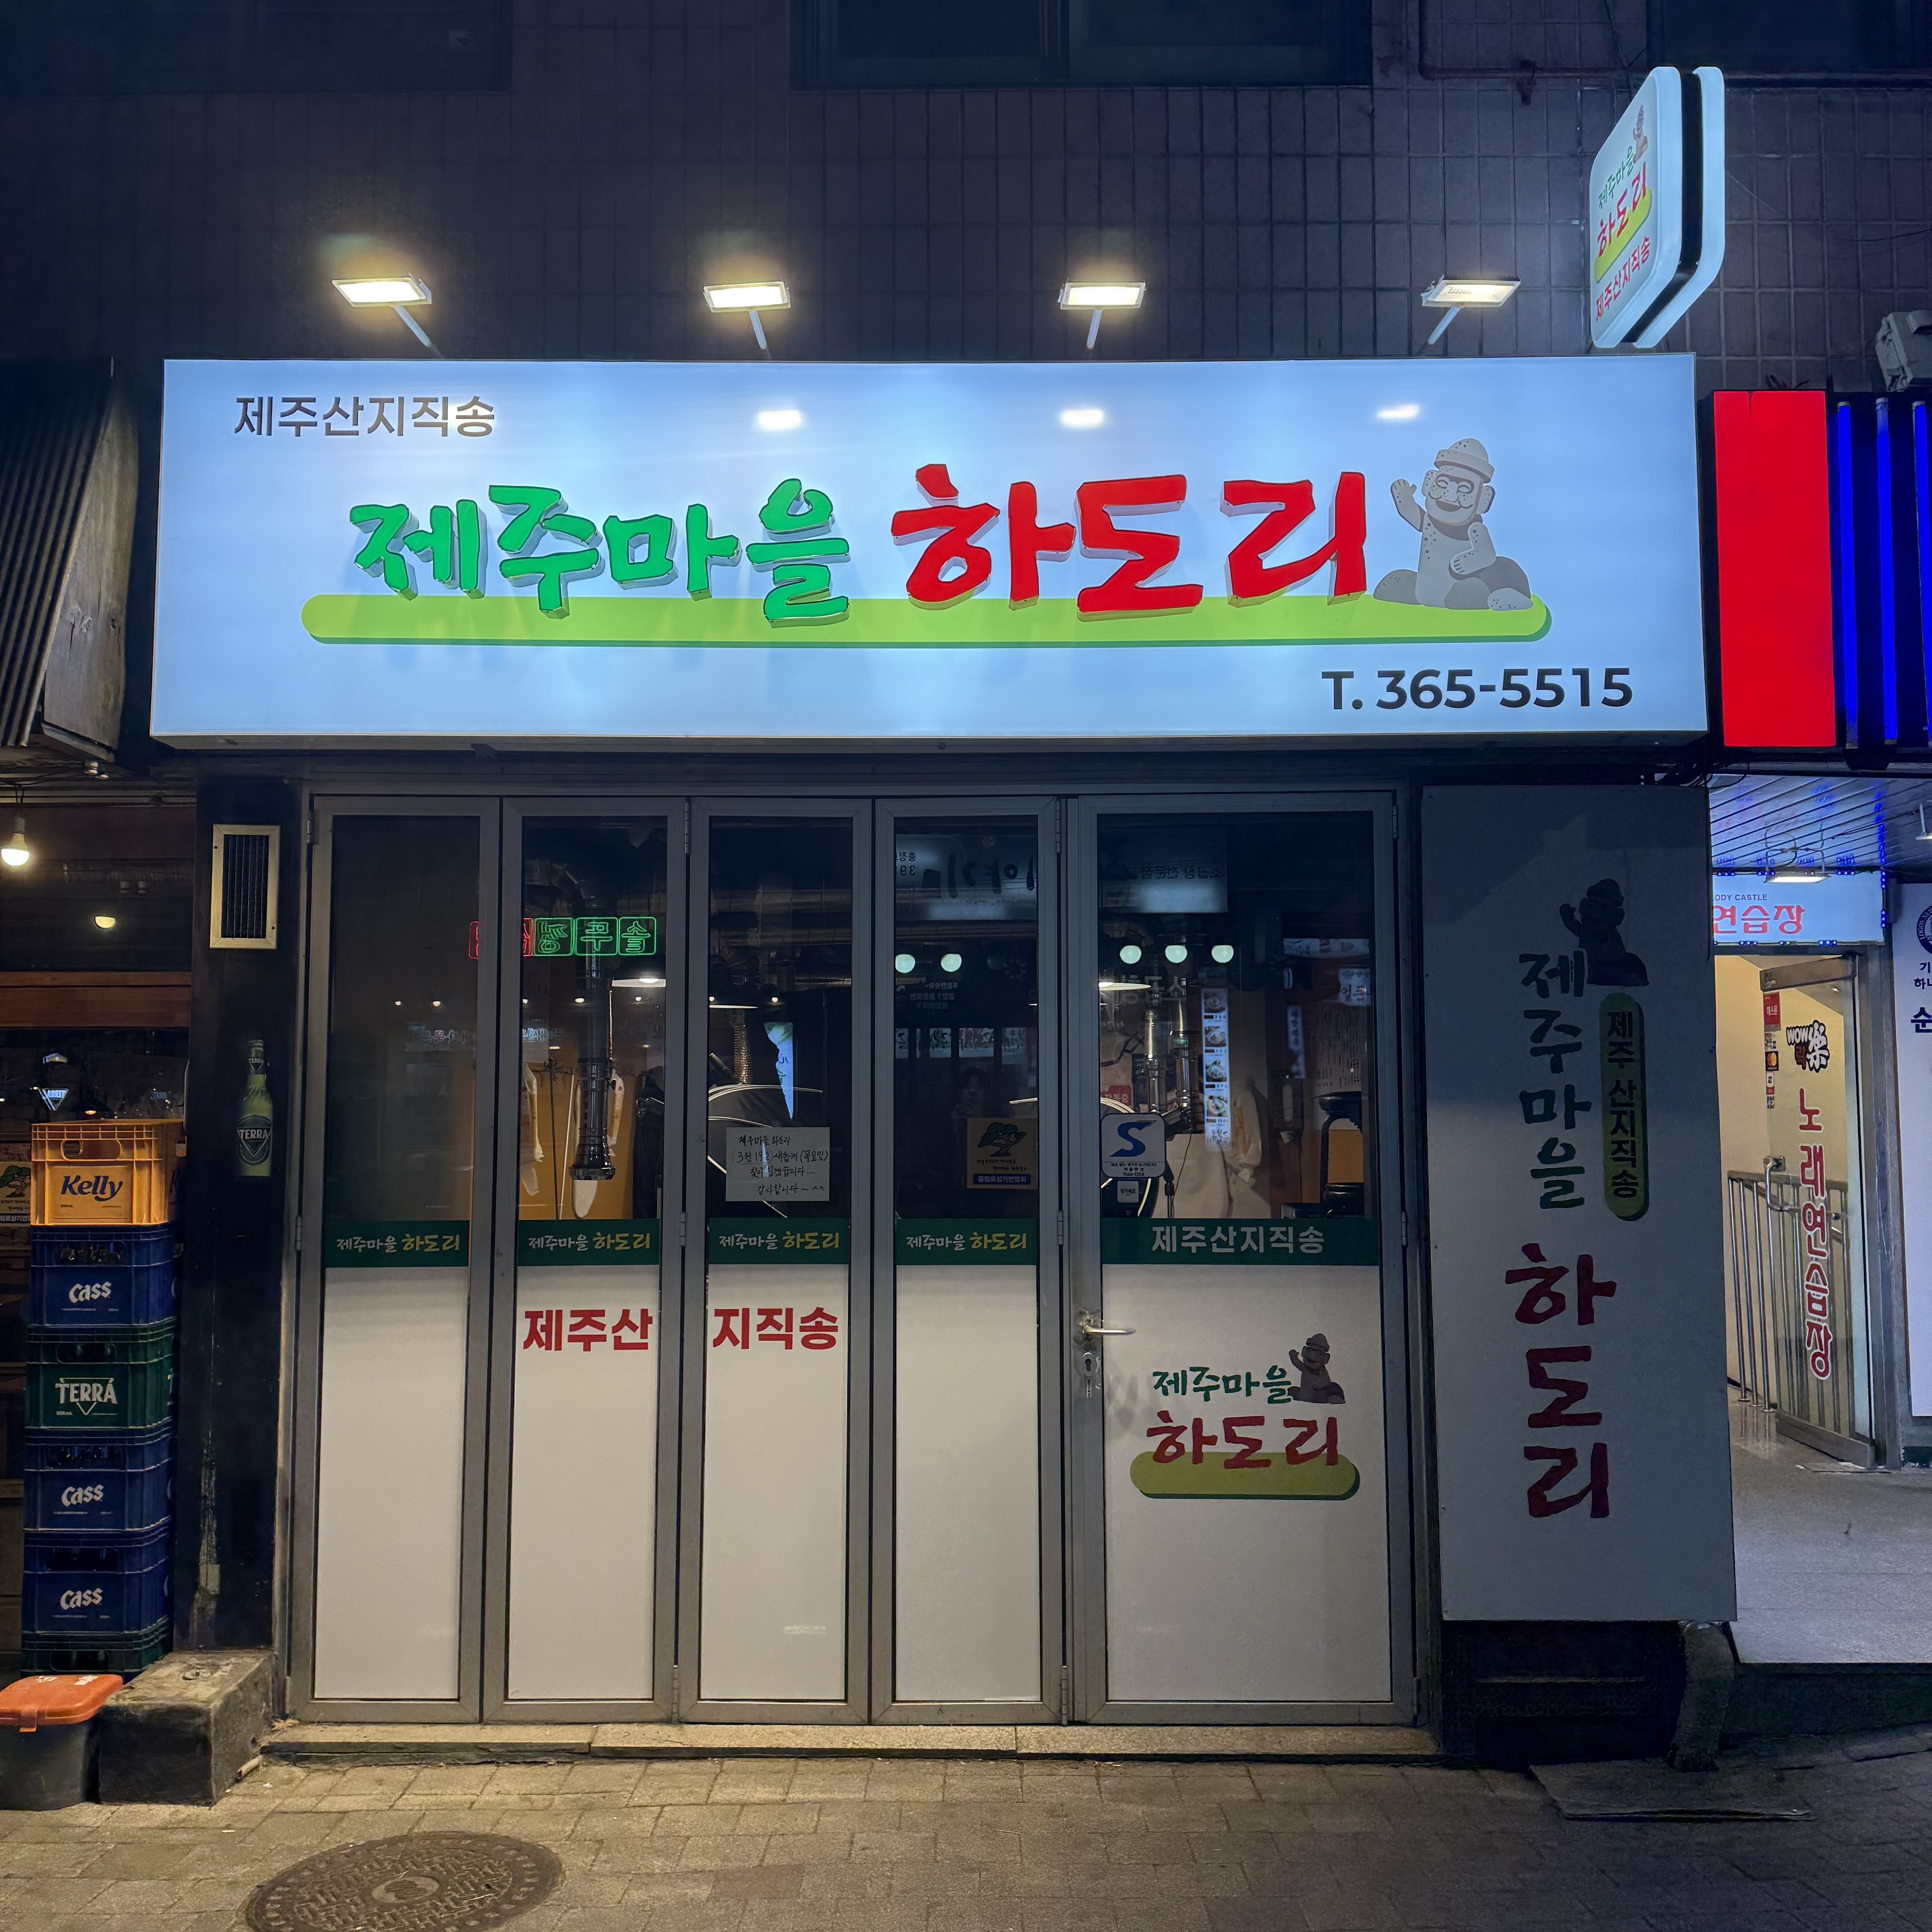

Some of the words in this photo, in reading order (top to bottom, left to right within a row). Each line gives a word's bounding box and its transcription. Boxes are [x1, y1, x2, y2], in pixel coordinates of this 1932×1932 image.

[1599, 145, 1634, 209] 제주마을
[1597, 162, 1646, 258] 하도리
[1596, 235, 1650, 322] 제주산지직송
[234, 395, 496, 437] 제주산지직송
[349, 478, 851, 629] 제주마을
[890, 463, 1368, 621] 하도리
[1321, 670, 1362, 711] T.
[1376, 668, 1633, 710] 365-5515
[1713, 905, 1805, 934] 연습장
[1786, 1026, 1809, 1044] WOW
[1519, 951, 1592, 1210] 제주마을
[239, 1129, 269, 1141] TERRA
[738, 1135, 769, 1146] 제주마을
[772, 1136, 790, 1146] 하도리
[773, 1151, 797, 1163] 새롭게
[800, 1150, 828, 1164] (목요일)
[60, 1175, 123, 1201] Kelly
[337, 1235, 397, 1253] 제주마을
[401, 1233, 460, 1252] 하도리
[528, 1234, 588, 1251] 제주마을
[593, 1232, 650, 1251] 하도리
[719, 1233, 778, 1250] 제주마을
[782, 1231, 839, 1249] 하도리
[907, 1233, 966, 1251] 제주마을
[969, 1232, 1026, 1250] 하도리
[1152, 1226, 1324, 1254] 제주산지직송
[1799, 1088, 1832, 1380] 노래연습장
[68, 1281, 111, 1303] Cass
[523, 1308, 653, 1352] 제주산
[712, 1306, 839, 1350] 지직송
[55, 1378, 118, 1404] TERRA
[1153, 1365, 1292, 1404] 제주마을
[1505, 1243, 1617, 1518] 하도리
[1146, 1410, 1339, 1469] 하도리
[61, 1484, 104, 1507] Cass
[60, 1587, 103, 1610] Cass
